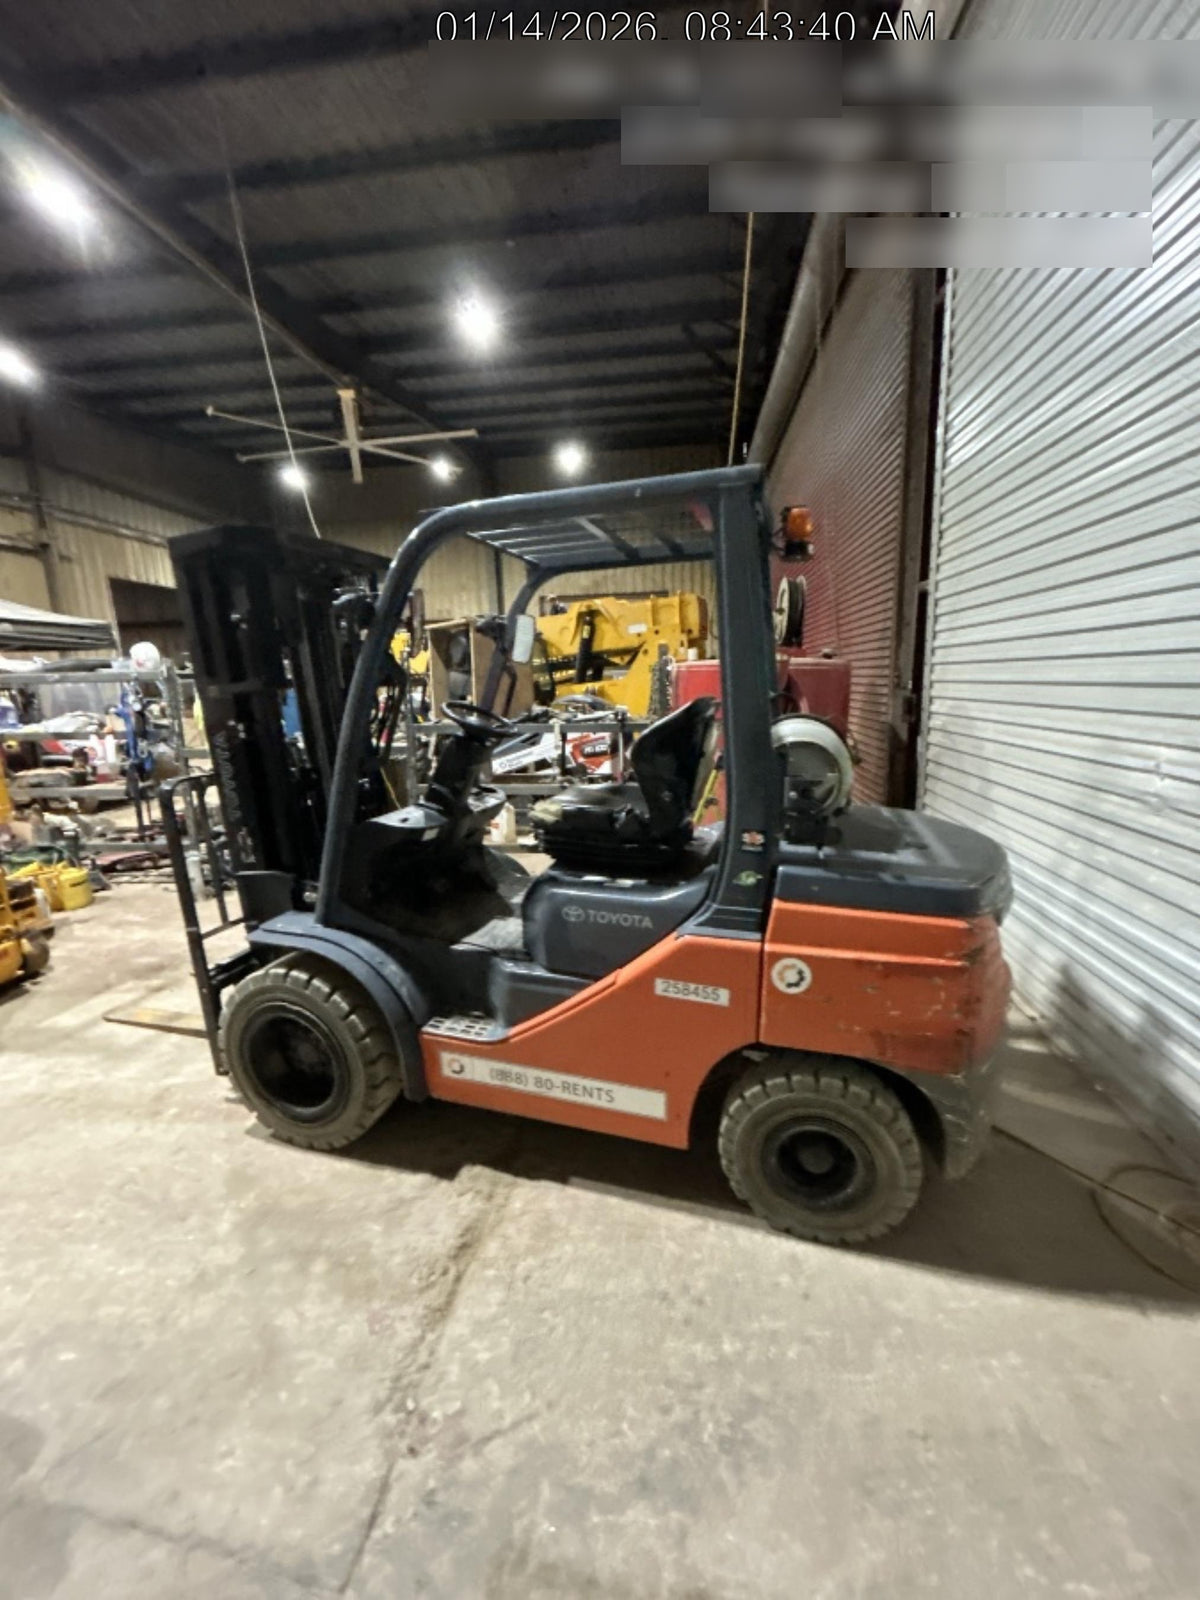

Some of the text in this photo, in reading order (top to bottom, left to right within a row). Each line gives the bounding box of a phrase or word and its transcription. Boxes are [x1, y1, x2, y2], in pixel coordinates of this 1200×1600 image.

[588, 909, 653, 929] TOYOTA
[661, 981, 721, 1002] 258455
[489, 1067, 616, 1103] (888) 80-RENTS
